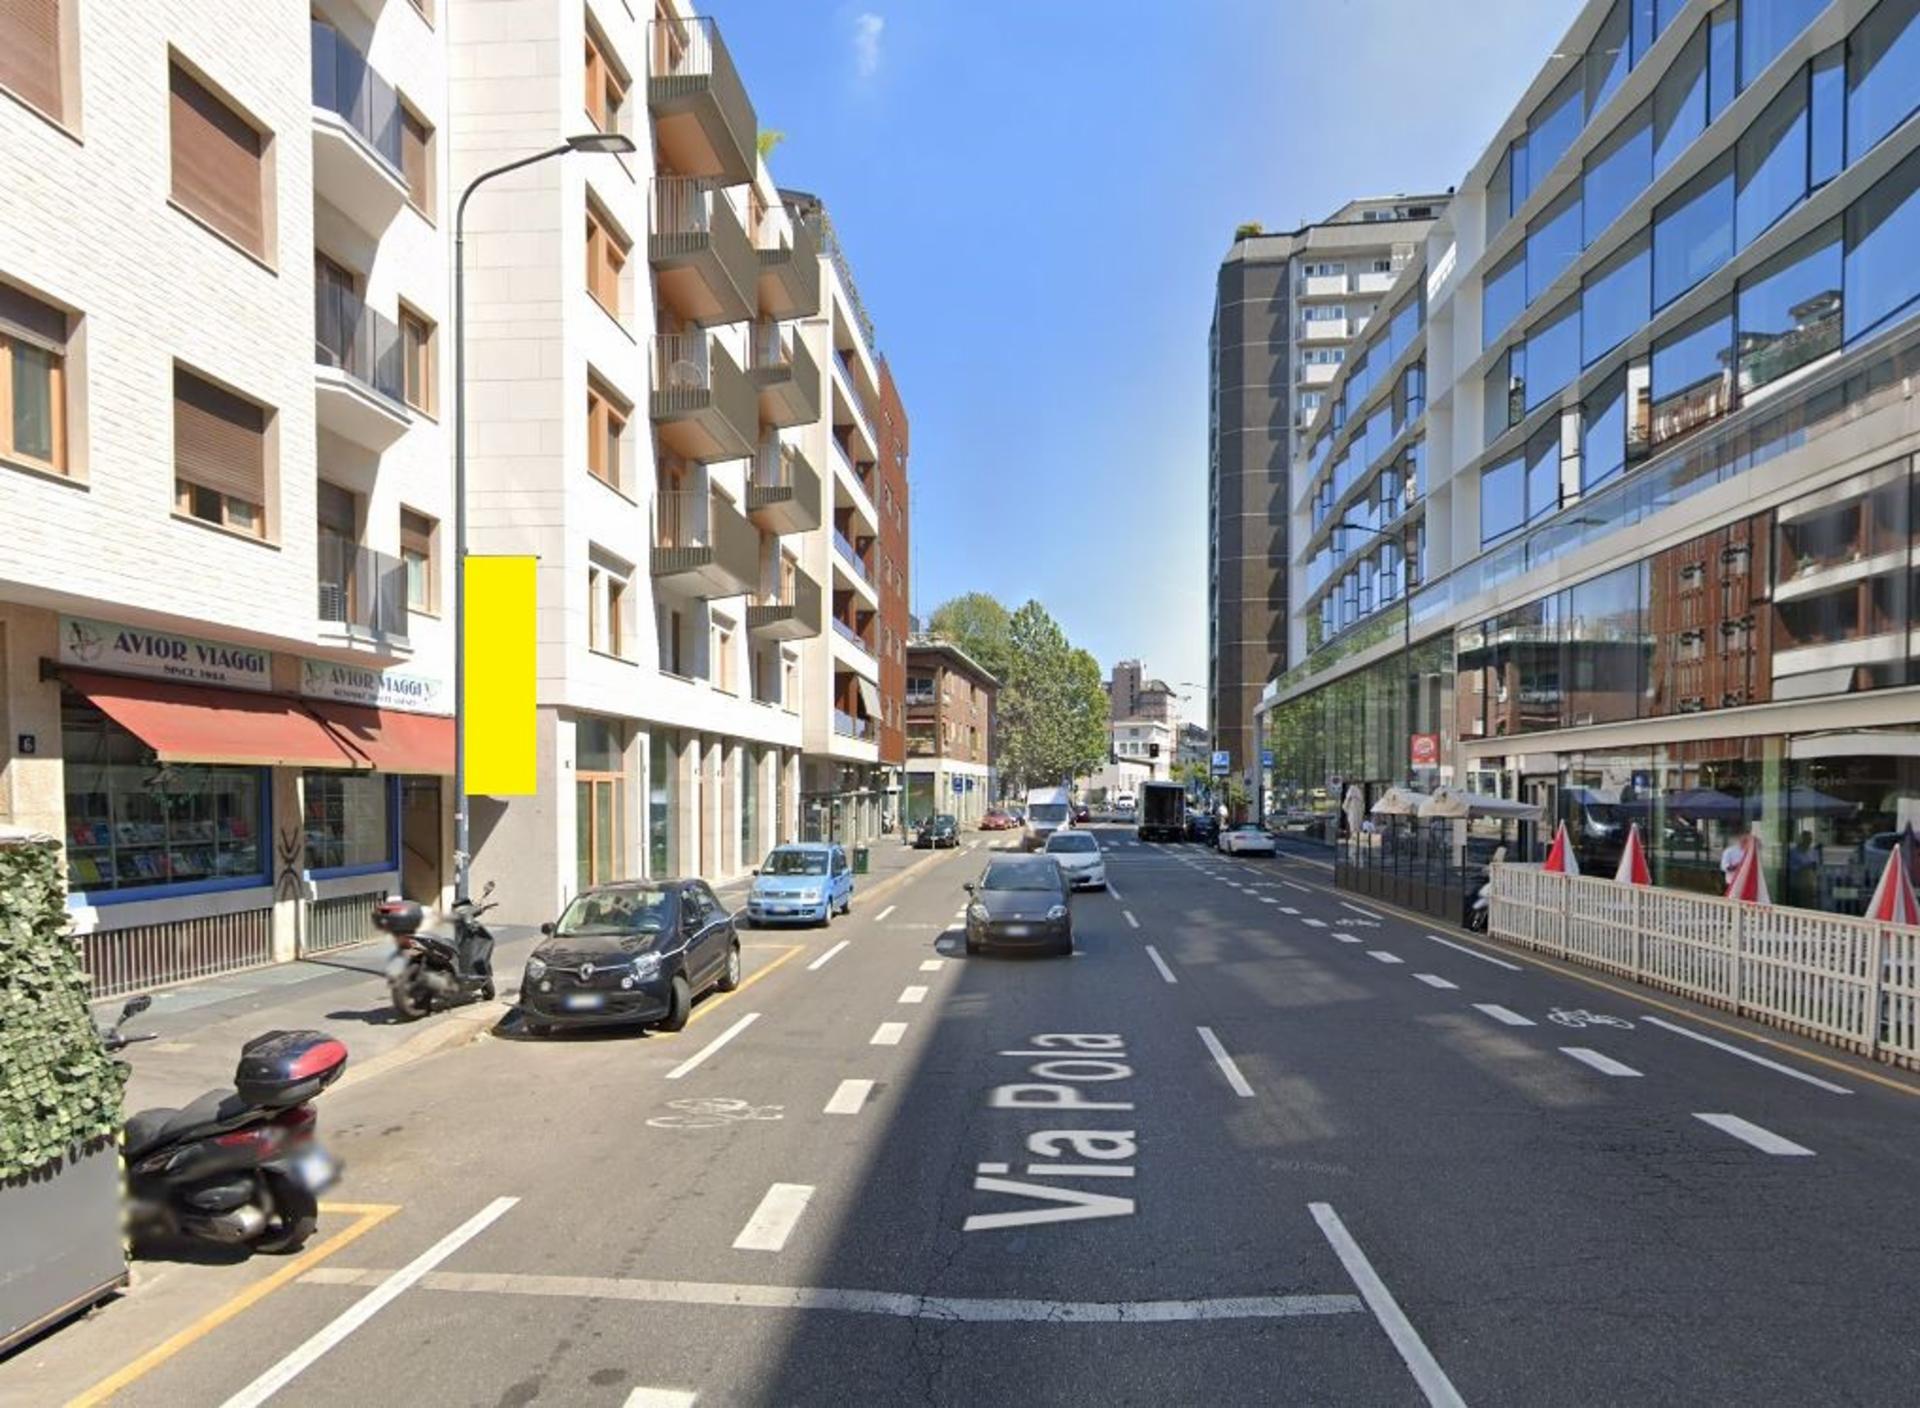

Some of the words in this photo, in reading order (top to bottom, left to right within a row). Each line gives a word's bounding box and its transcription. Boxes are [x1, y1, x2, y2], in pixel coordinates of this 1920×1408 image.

[114, 632, 187, 661] AVIOR
[196, 645, 265, 672] VIAGGI
[330, 667, 375, 690] AVIOR
[377, 675, 422, 696] VIAGGI
[990, 1033, 1135, 1110] Pola
[963, 1129, 1137, 1231] Via
